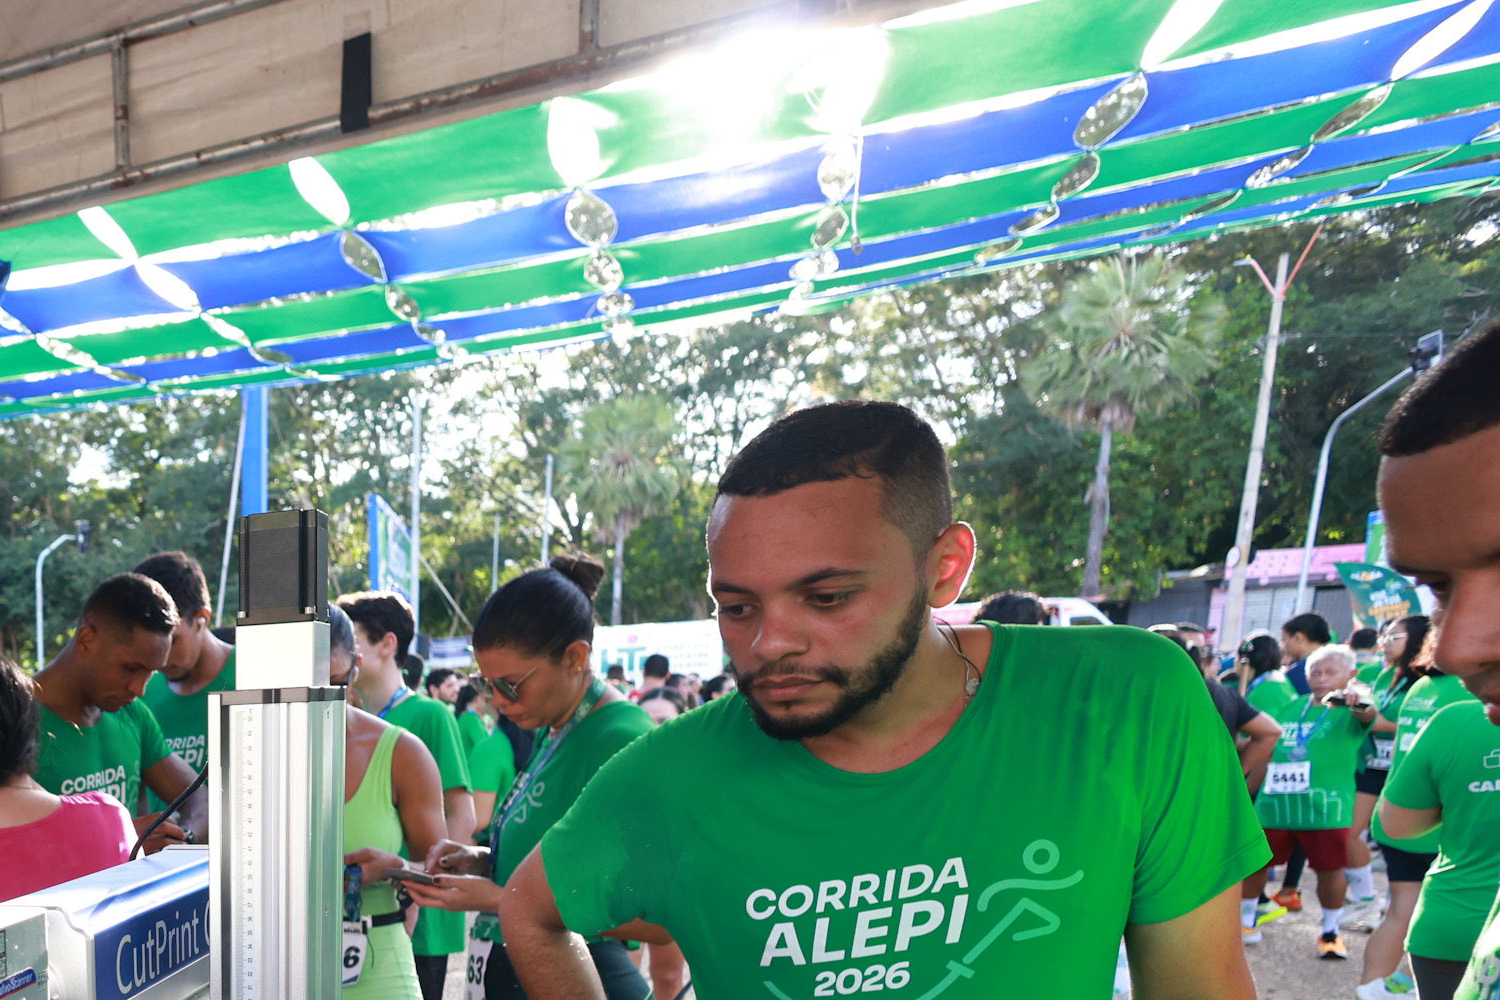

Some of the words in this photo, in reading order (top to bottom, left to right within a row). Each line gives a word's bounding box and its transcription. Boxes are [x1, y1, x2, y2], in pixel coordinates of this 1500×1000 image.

[165, 734, 205, 749] RRIDA
[61, 765, 126, 795] CORRIDA
[1468, 779, 1500, 793] CAI
[746, 856, 969, 921] CORRIDA
[760, 893, 969, 967] ALEPI
[116, 908, 199, 994] CutPrint
[813, 961, 911, 997] 2026
